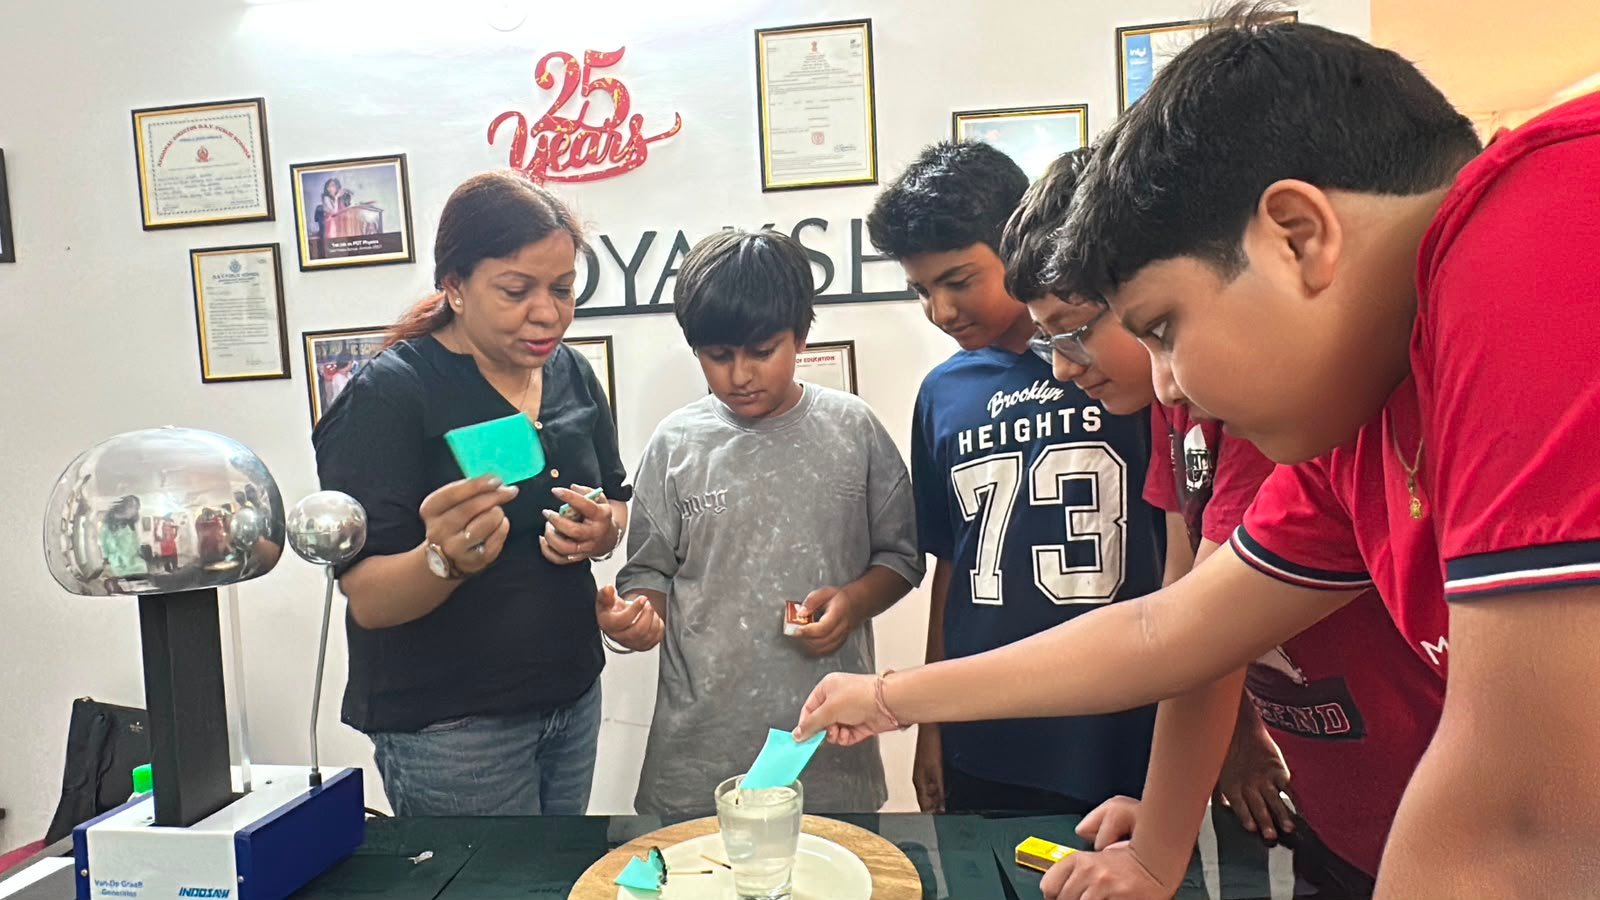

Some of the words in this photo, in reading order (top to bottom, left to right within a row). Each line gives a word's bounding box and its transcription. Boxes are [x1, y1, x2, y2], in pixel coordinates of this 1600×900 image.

[534, 46, 631, 138] 25
[487, 110, 682, 186] Years
[957, 405, 1102, 455] HEIGHTS
[986, 379, 1065, 419] Brooklyn
[950, 440, 1128, 606] 73
